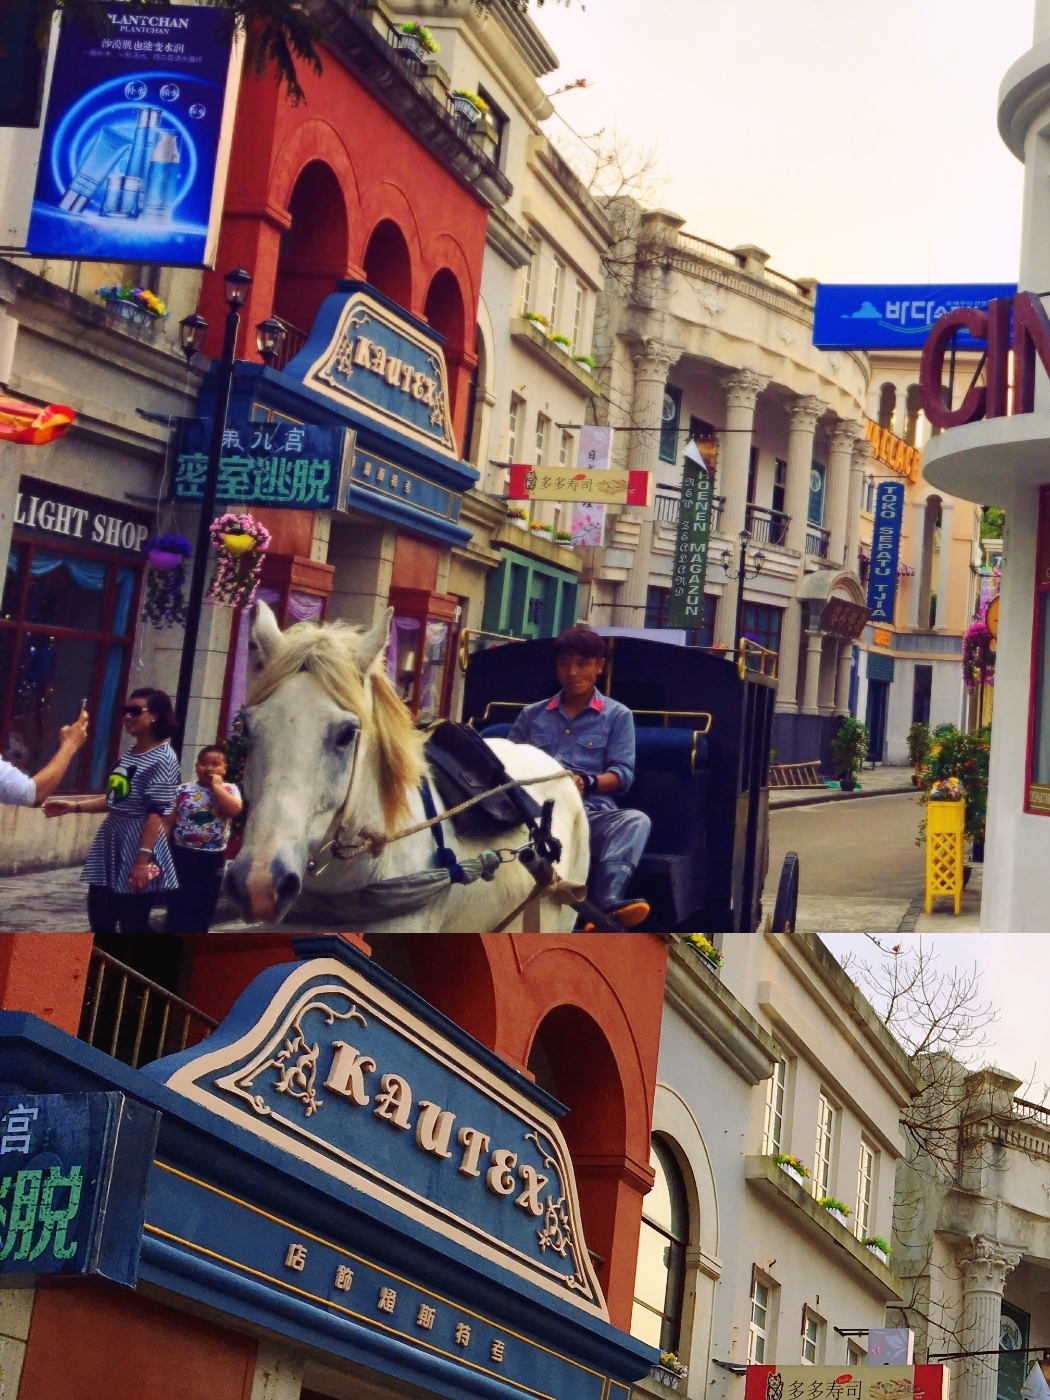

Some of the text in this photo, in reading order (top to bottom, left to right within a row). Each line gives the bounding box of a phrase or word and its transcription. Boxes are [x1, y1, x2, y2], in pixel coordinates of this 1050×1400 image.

[120, 25, 170, 34] PLANTCHAN
[355, 336, 437, 404] KAUTEX
[175, 452, 331, 503] 密室逃脱
[540, 475, 593, 493] 多多寿司
[880, 486, 898, 519] TOKO
[14, 493, 148, 552] LIGHT SHOP
[875, 526, 894, 576] SEPATU
[0, 1104, 38, 1155] 宫
[325, 1040, 549, 1217] KAUTEX
[0, 1166, 82, 1261] 脱
[787, 1380, 862, 1400] 多多寿司
